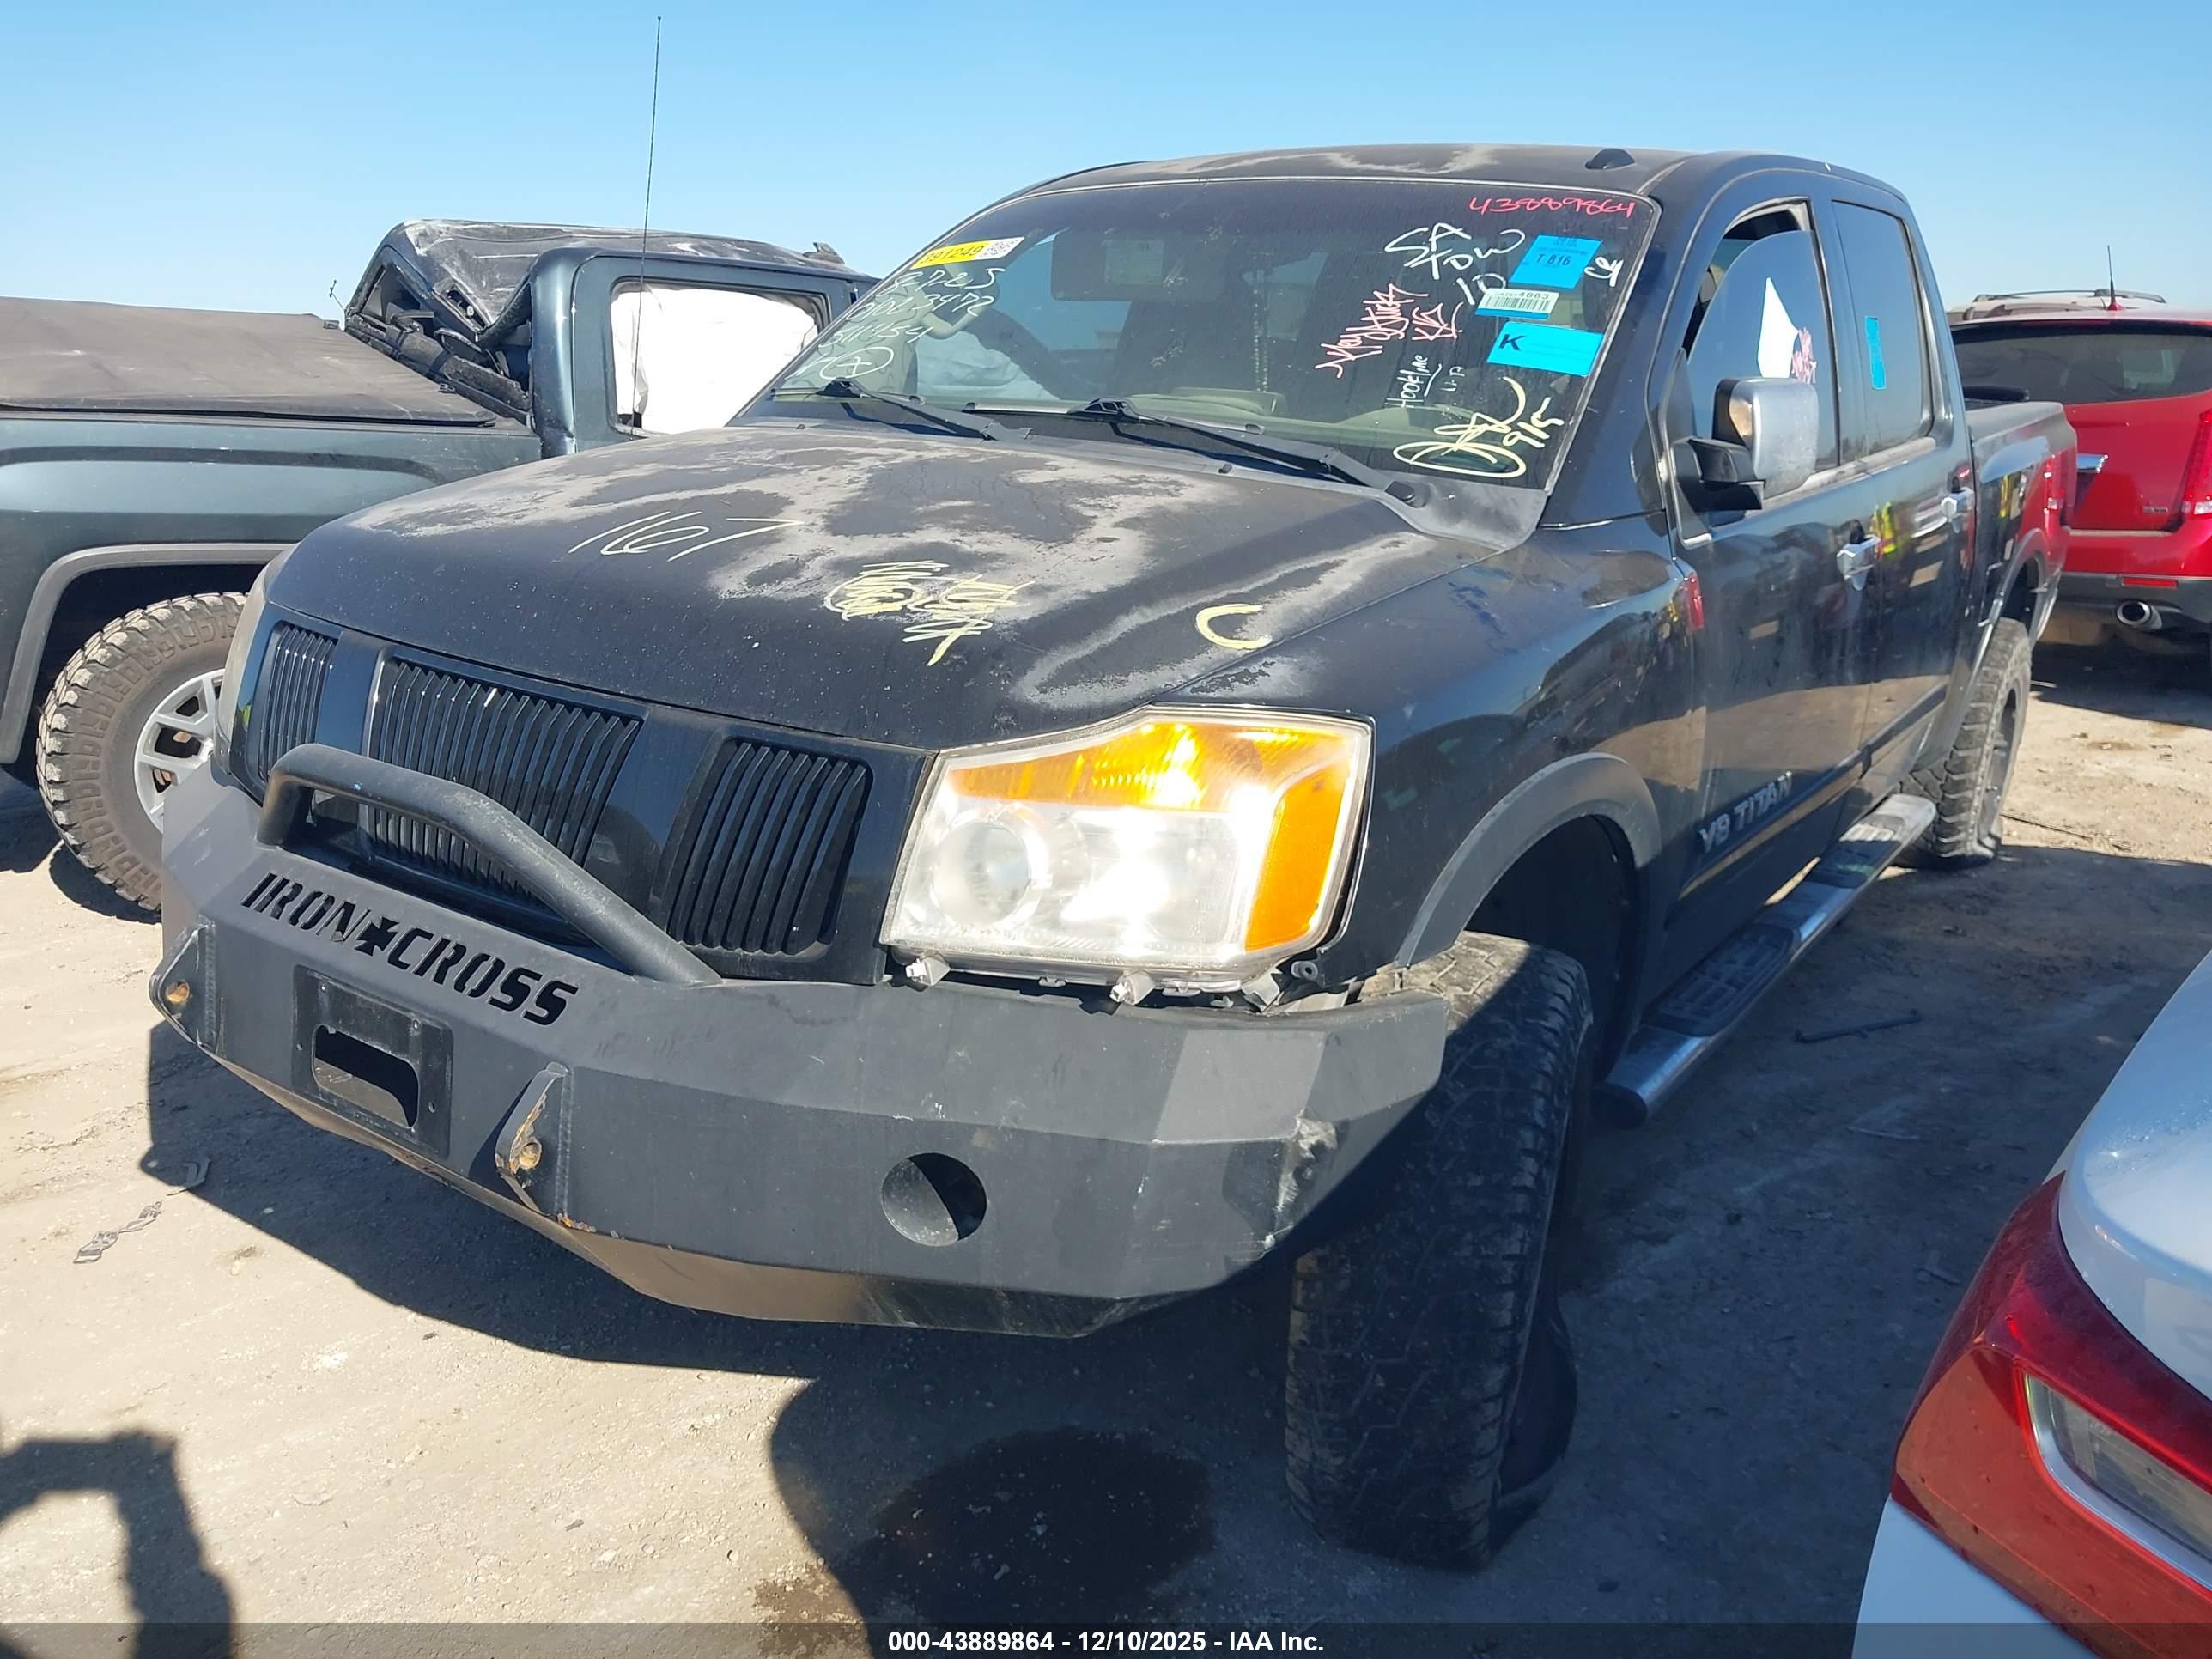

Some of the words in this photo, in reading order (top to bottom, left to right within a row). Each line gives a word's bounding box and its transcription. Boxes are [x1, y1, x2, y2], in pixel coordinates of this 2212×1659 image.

[1469, 197, 1636, 218] 43889864
[1498, 333, 1526, 351] K
[1699, 813, 1731, 853] V8
[1733, 770, 1793, 831] TITAN
[240, 872, 371, 942] IRON
[386, 927, 580, 1027] CROSS
